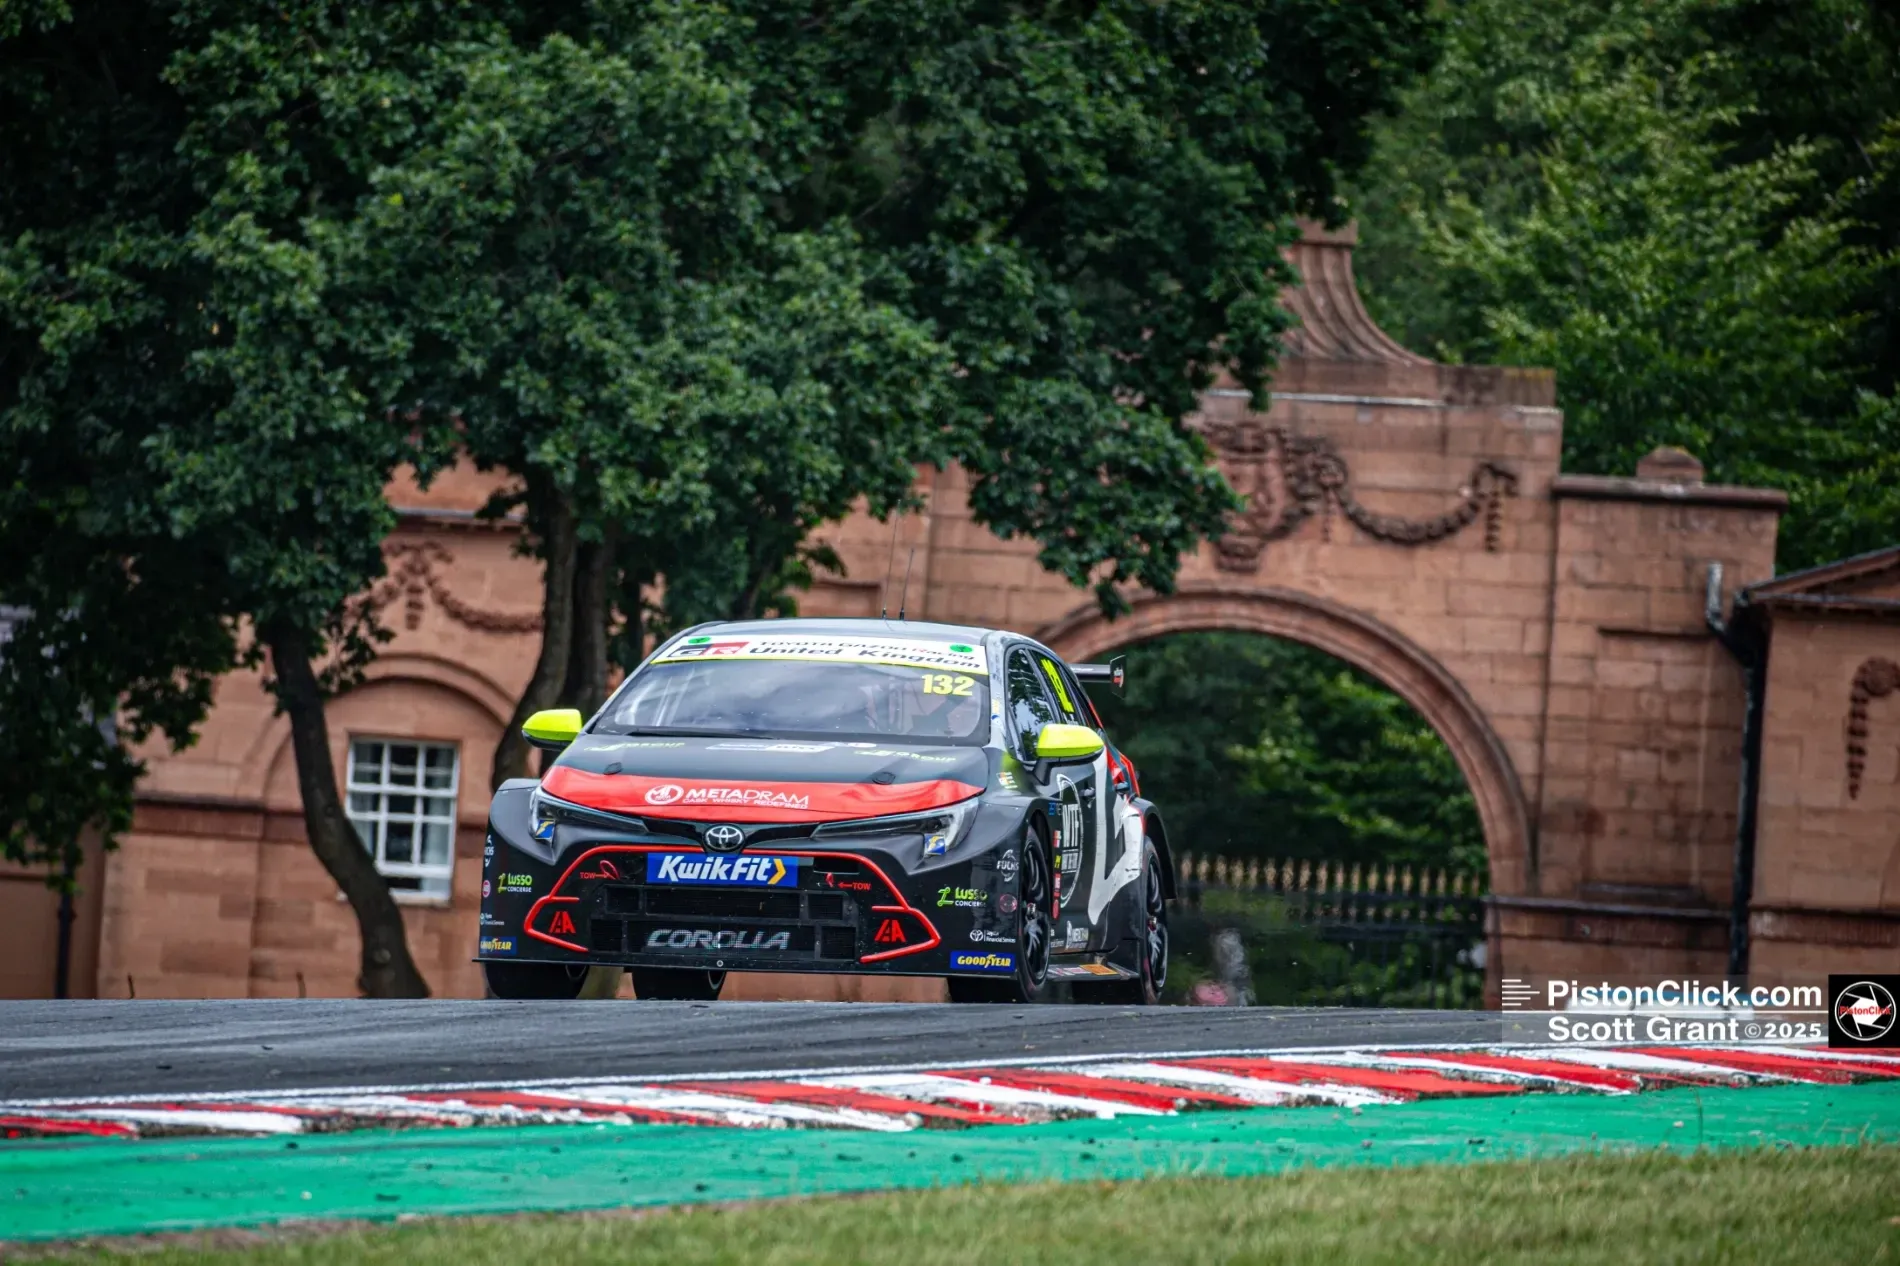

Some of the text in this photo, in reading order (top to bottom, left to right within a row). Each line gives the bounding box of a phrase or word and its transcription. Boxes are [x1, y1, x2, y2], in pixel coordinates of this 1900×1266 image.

[749, 647, 981, 669] United Kingdom
[921, 674, 975, 696] 132
[686, 788, 810, 804] METADRAM
[996, 860, 1020, 871] FUCHS
[507, 873, 533, 886] LUSSO
[852, 882, 871, 890] TOW
[955, 887, 988, 900] LUSSO
[647, 929, 791, 950] COROLLA
[957, 954, 1012, 968] GOODYEAR
